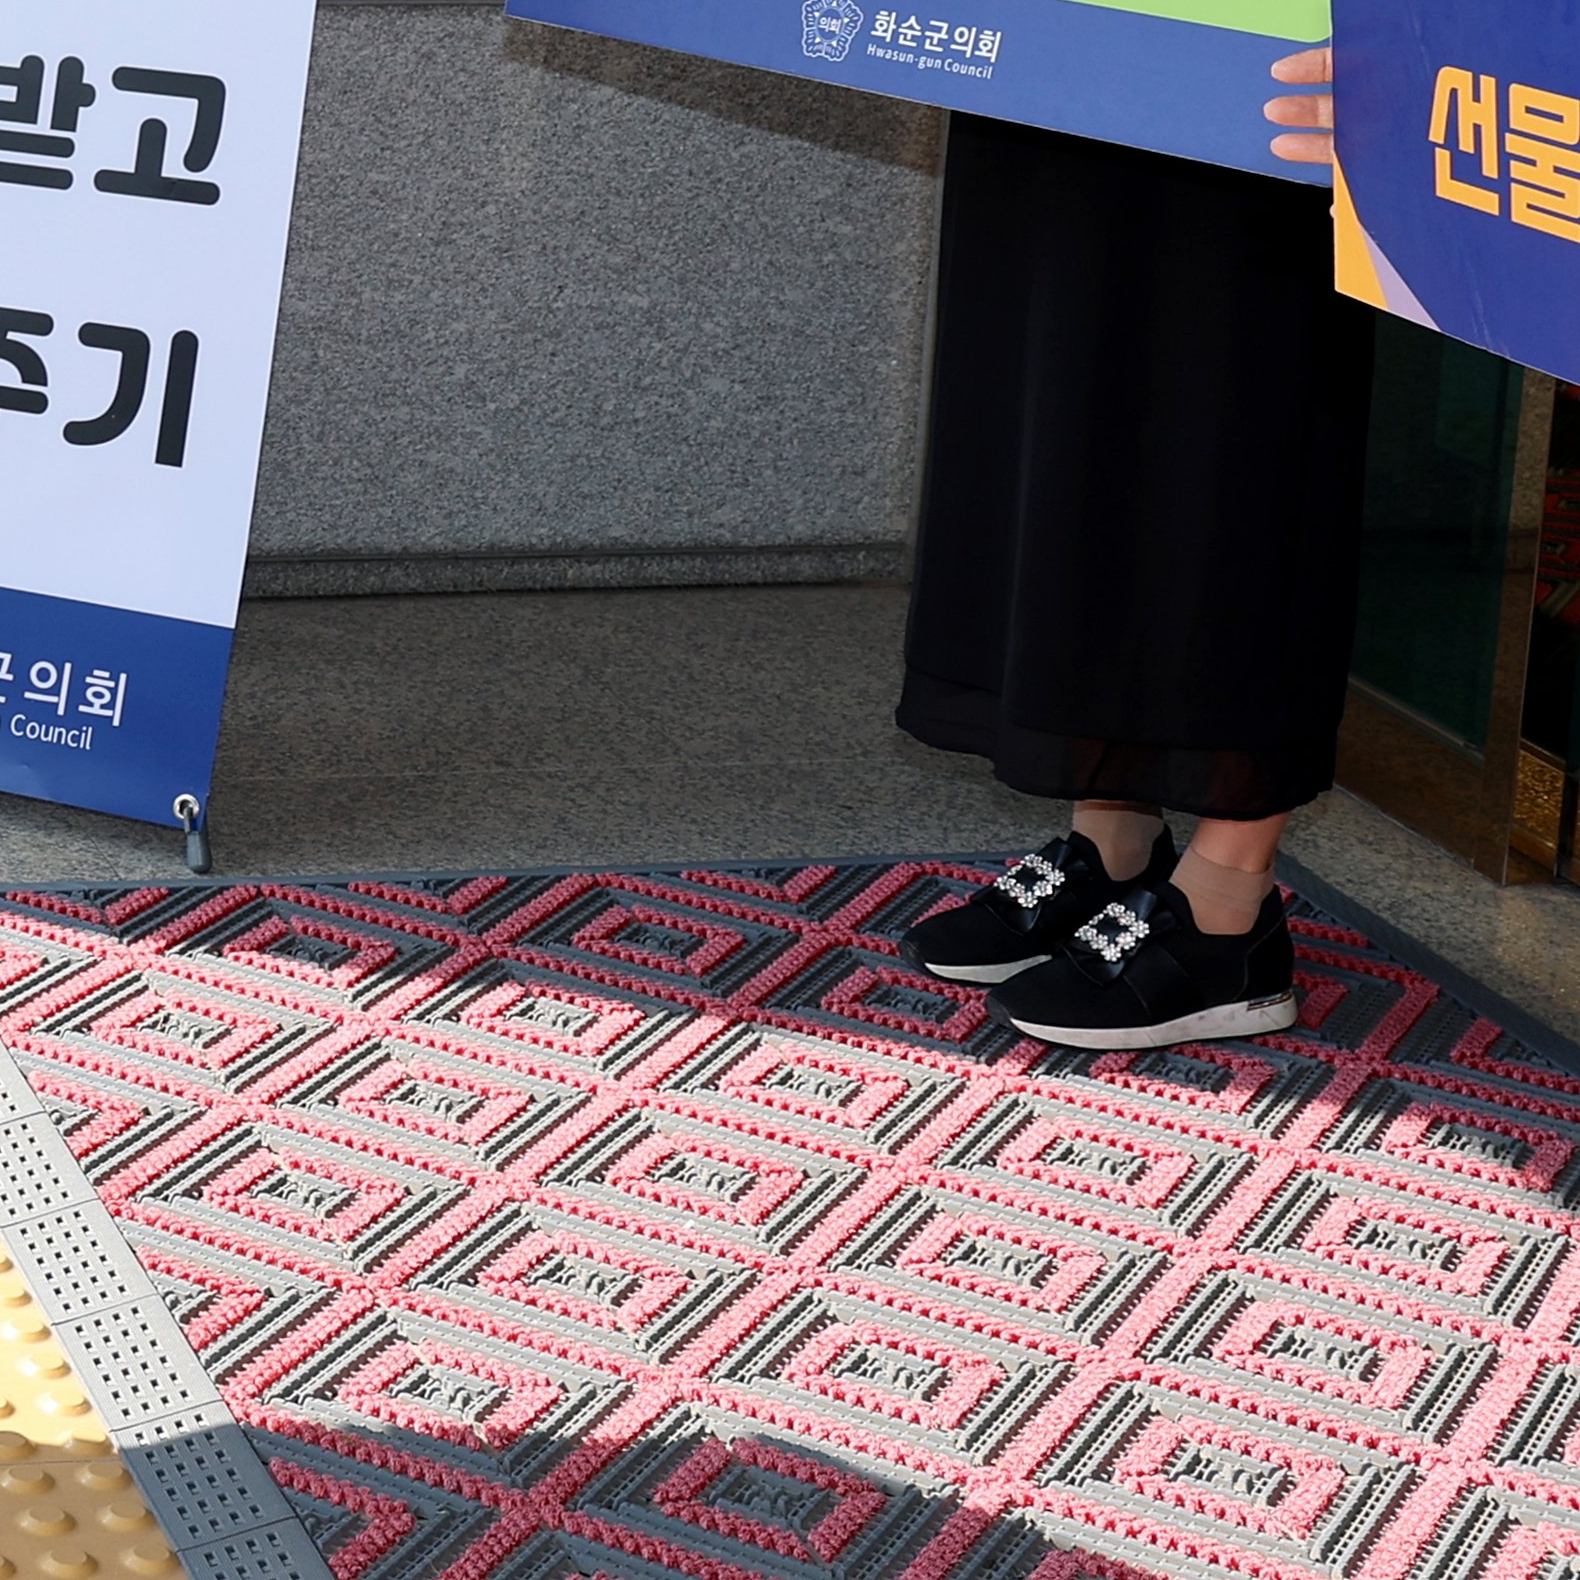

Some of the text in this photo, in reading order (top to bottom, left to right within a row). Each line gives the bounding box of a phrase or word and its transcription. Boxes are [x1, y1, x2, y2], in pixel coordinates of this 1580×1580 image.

[870, 8, 1003, 65] 화순군의회
[866, 43, 994, 81] Hwasun-gun Council
[1427, 64, 1580, 245] 선물
[10, 712, 94, 751] Council
